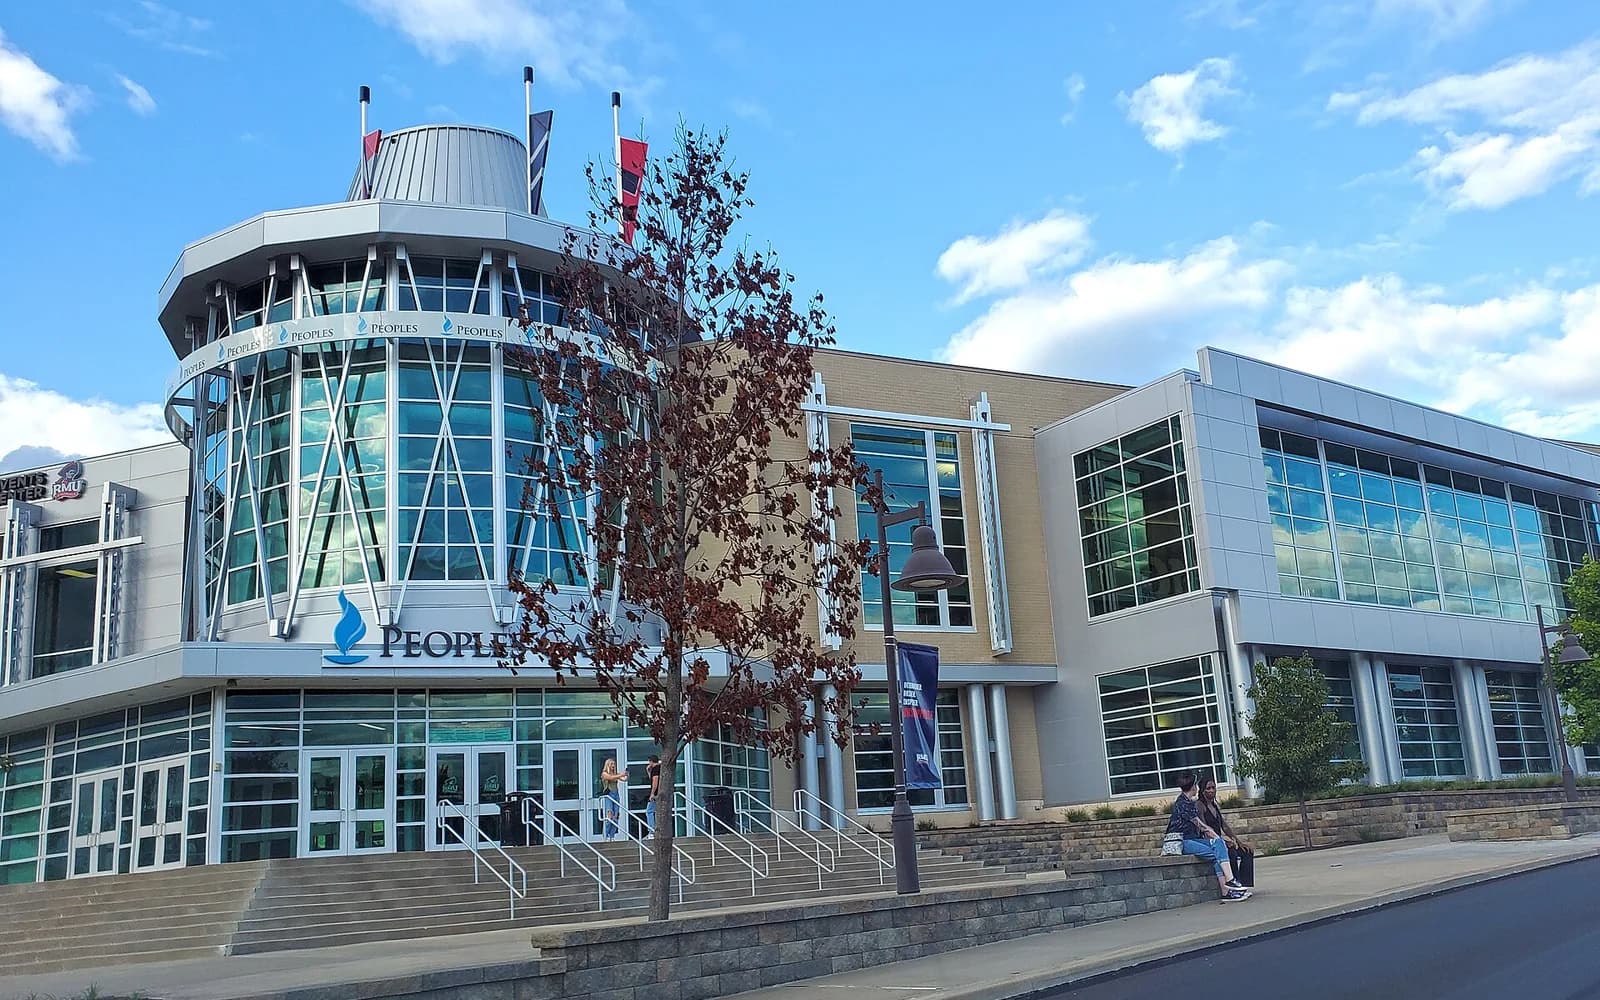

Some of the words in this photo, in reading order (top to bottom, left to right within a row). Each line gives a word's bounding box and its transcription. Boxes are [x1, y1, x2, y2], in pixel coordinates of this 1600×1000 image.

[291, 328, 334, 342] PEOPLES
[371, 323, 418, 334] PEOPLES
[456, 325, 503, 338] PEOPLES
[227, 341, 260, 358] PEOPLES
[54, 481, 80, 498] RMU
